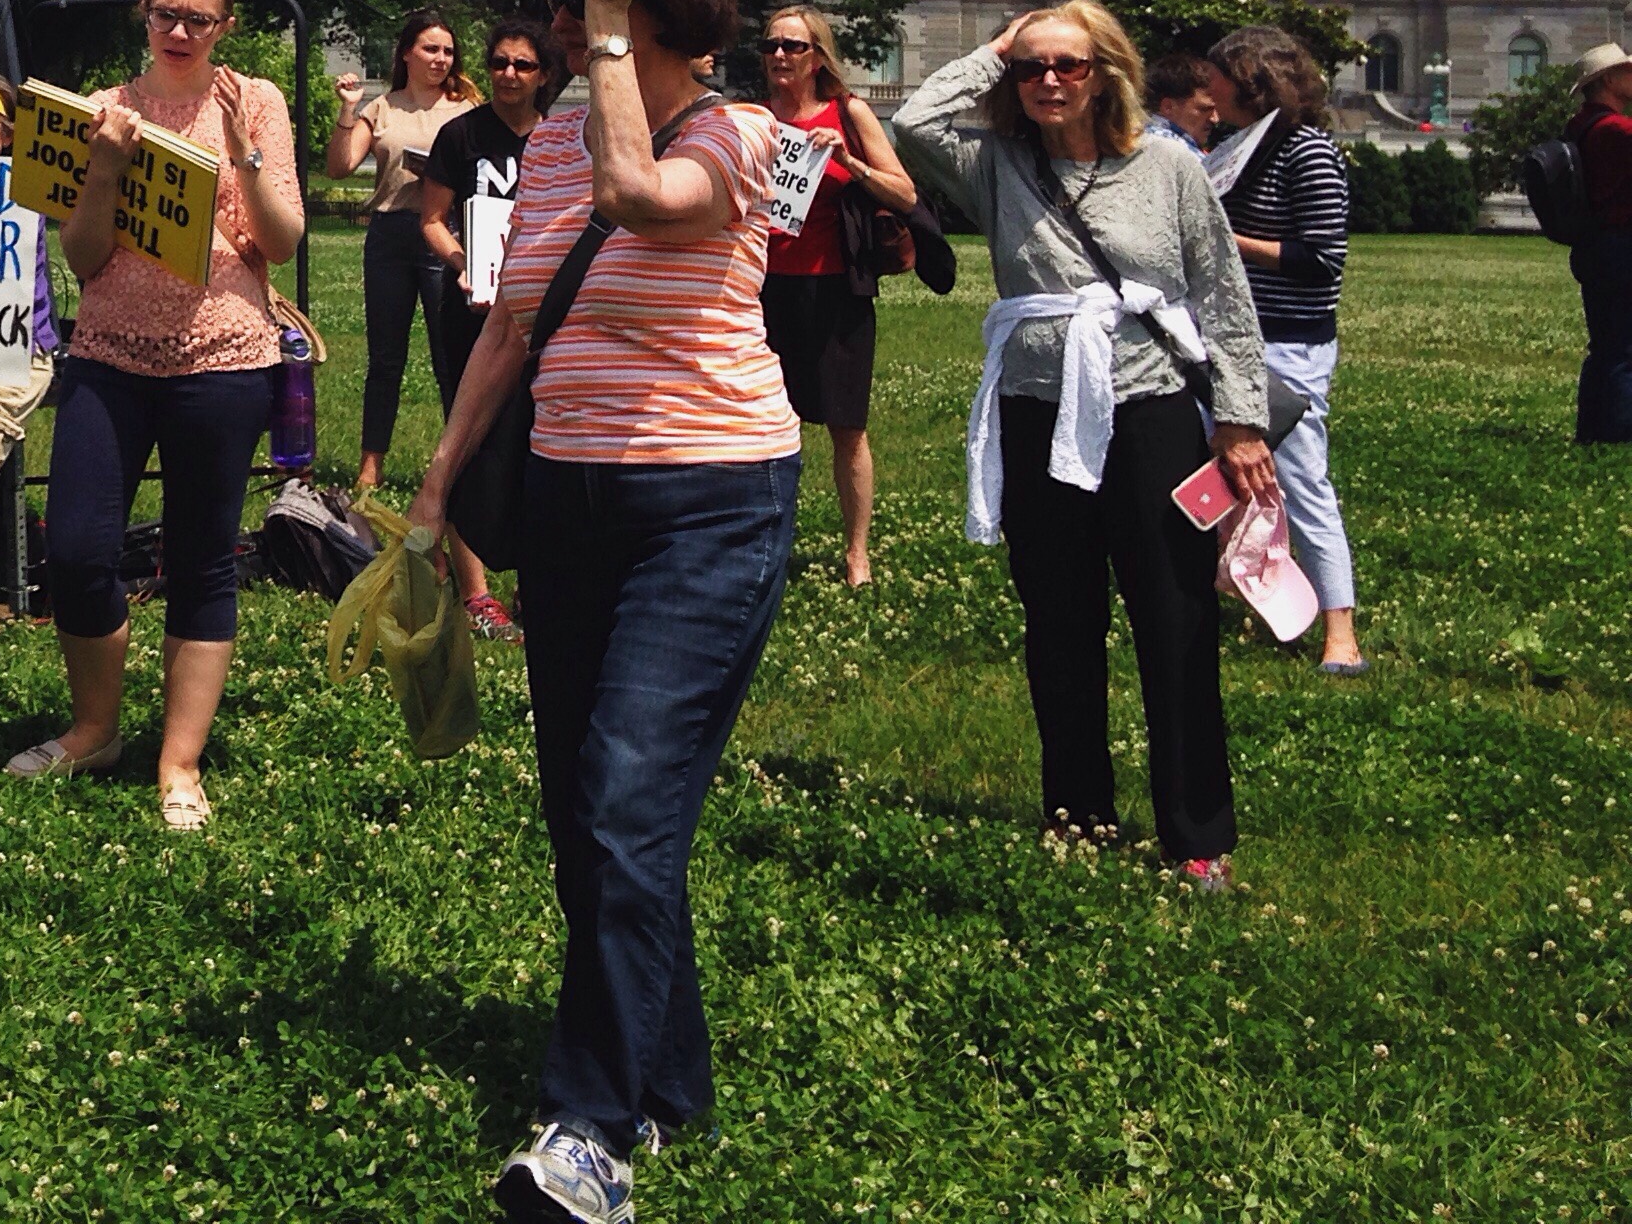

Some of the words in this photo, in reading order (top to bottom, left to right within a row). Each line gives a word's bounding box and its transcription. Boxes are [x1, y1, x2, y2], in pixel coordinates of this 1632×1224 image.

[46, 182, 79, 210] ar
[121, 175, 149, 213] th
[164, 161, 188, 199] is
[157, 194, 190, 228] on
[114, 208, 162, 260] The
